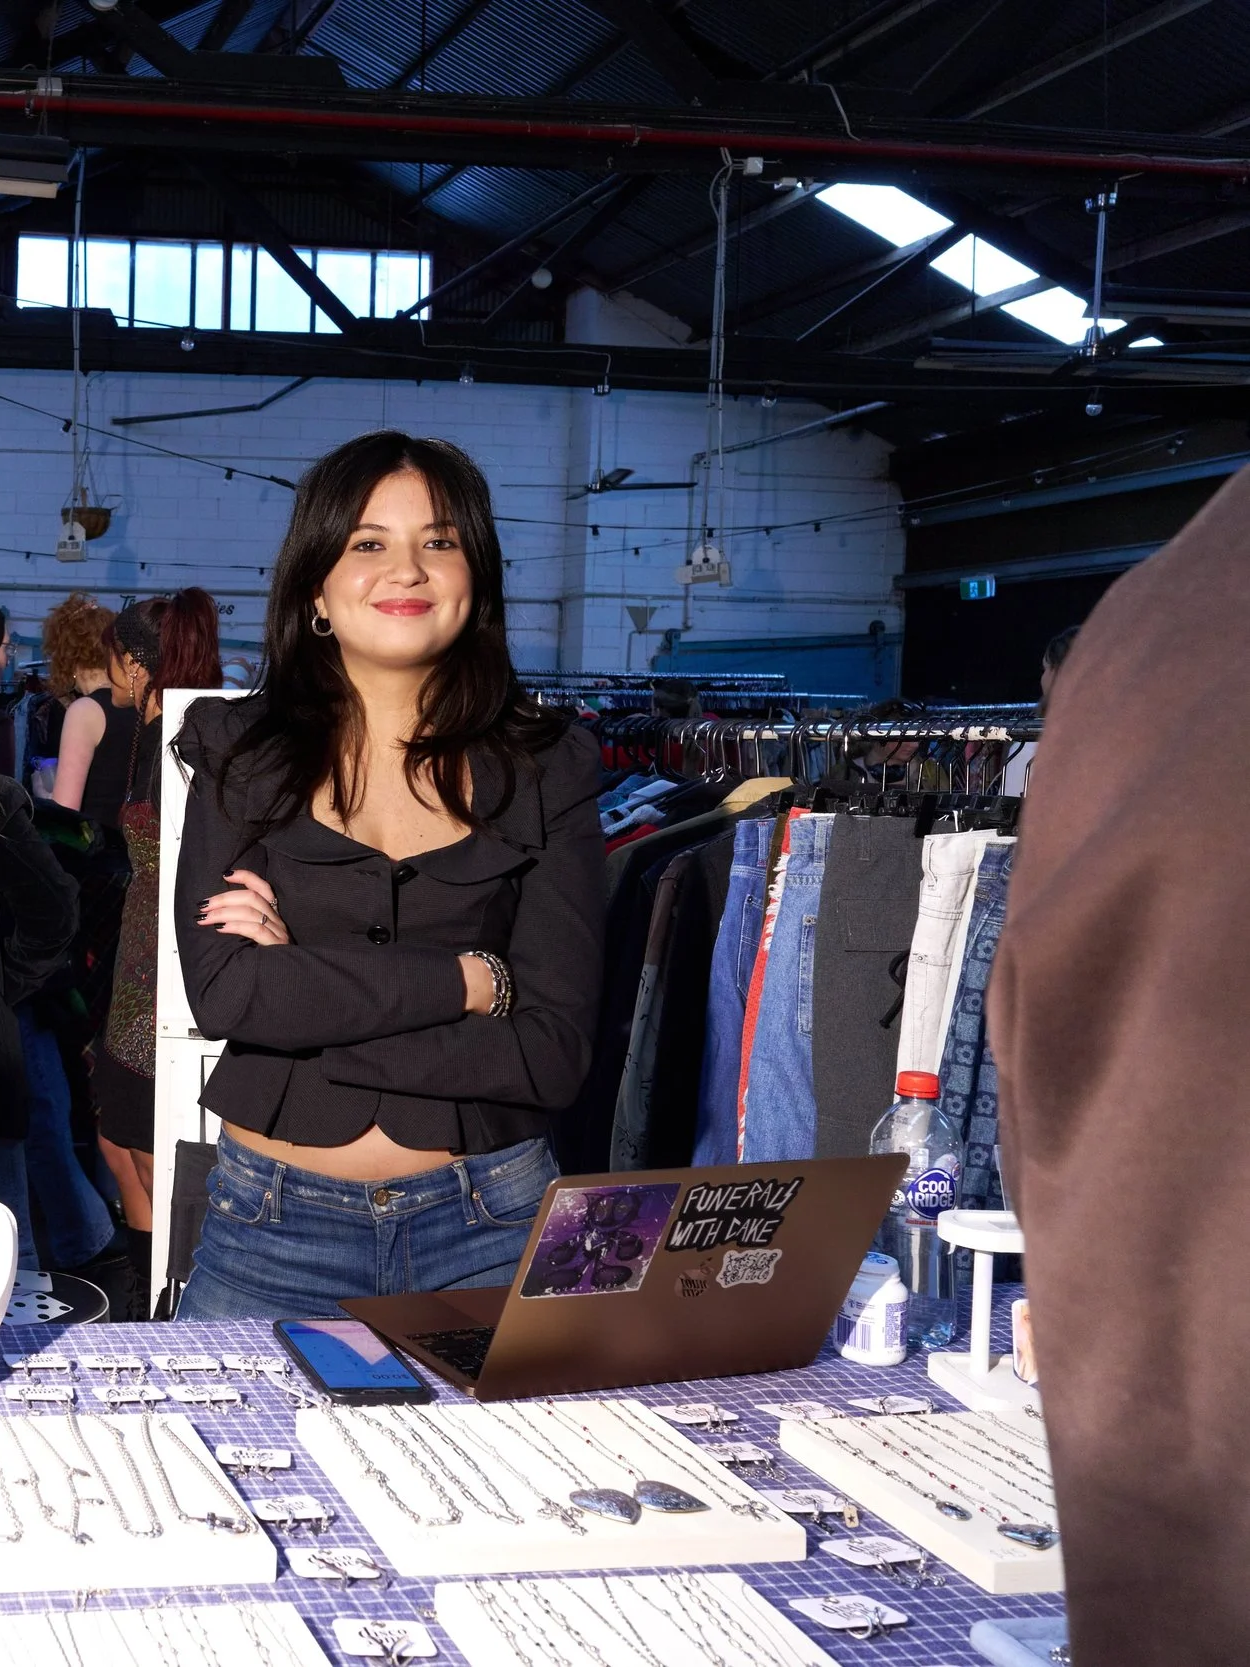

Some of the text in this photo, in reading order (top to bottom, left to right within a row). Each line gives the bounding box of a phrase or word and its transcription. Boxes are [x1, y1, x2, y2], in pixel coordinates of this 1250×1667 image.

[682, 1179, 800, 1214] FUNERALS
[918, 1180, 953, 1194] COOL
[914, 1193, 954, 1208] RIDGE
[669, 1217, 779, 1247] WITH CAKE
